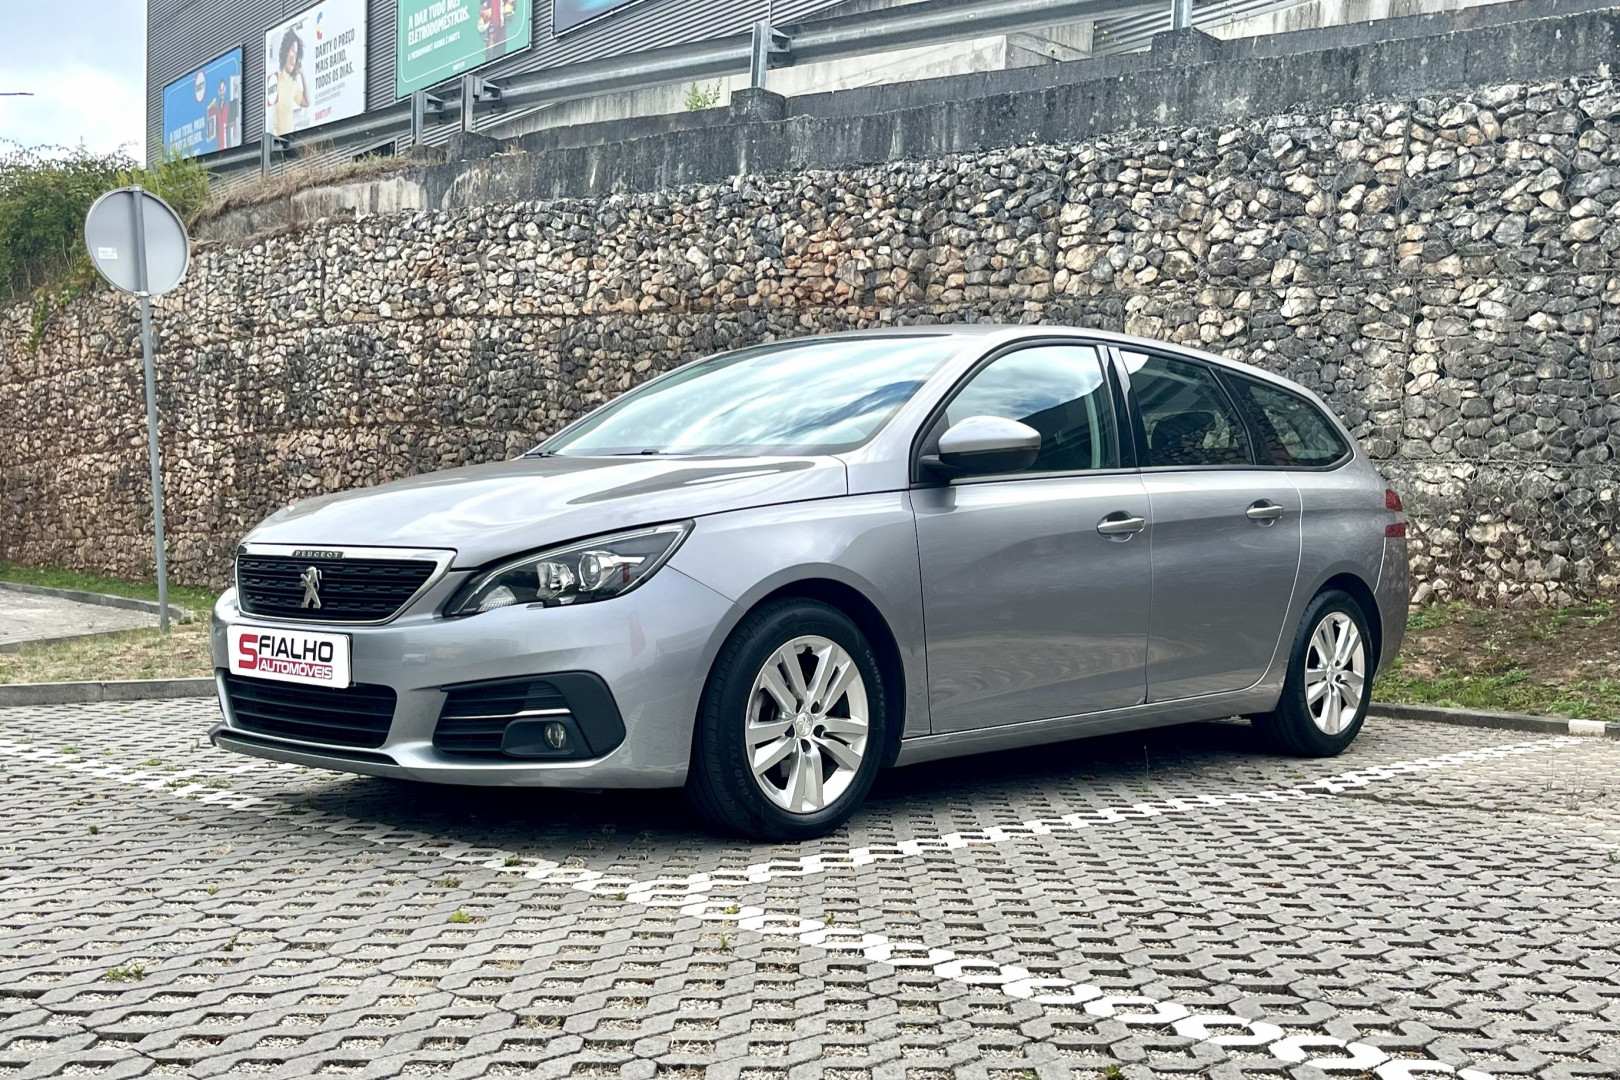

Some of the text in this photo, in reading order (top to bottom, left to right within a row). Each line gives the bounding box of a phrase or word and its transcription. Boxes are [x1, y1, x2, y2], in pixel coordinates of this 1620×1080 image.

[408, 15, 413, 30] A
[414, 10, 428, 27] DAR
[428, 1, 446, 20] TUDO
[408, 5, 470, 46] ELETRODOMÉSTICOS.
[315, 28, 355, 59] DARTY O PREÇO
[315, 57, 328, 74] MAIS
[315, 72, 332, 90] TODOS
[332, 69, 339, 82] OS
[295, 550, 340, 558] PEUGEOT
[259, 635, 334, 663] FIALHO
[260, 659, 333, 679] AUTOMÓVEIS
